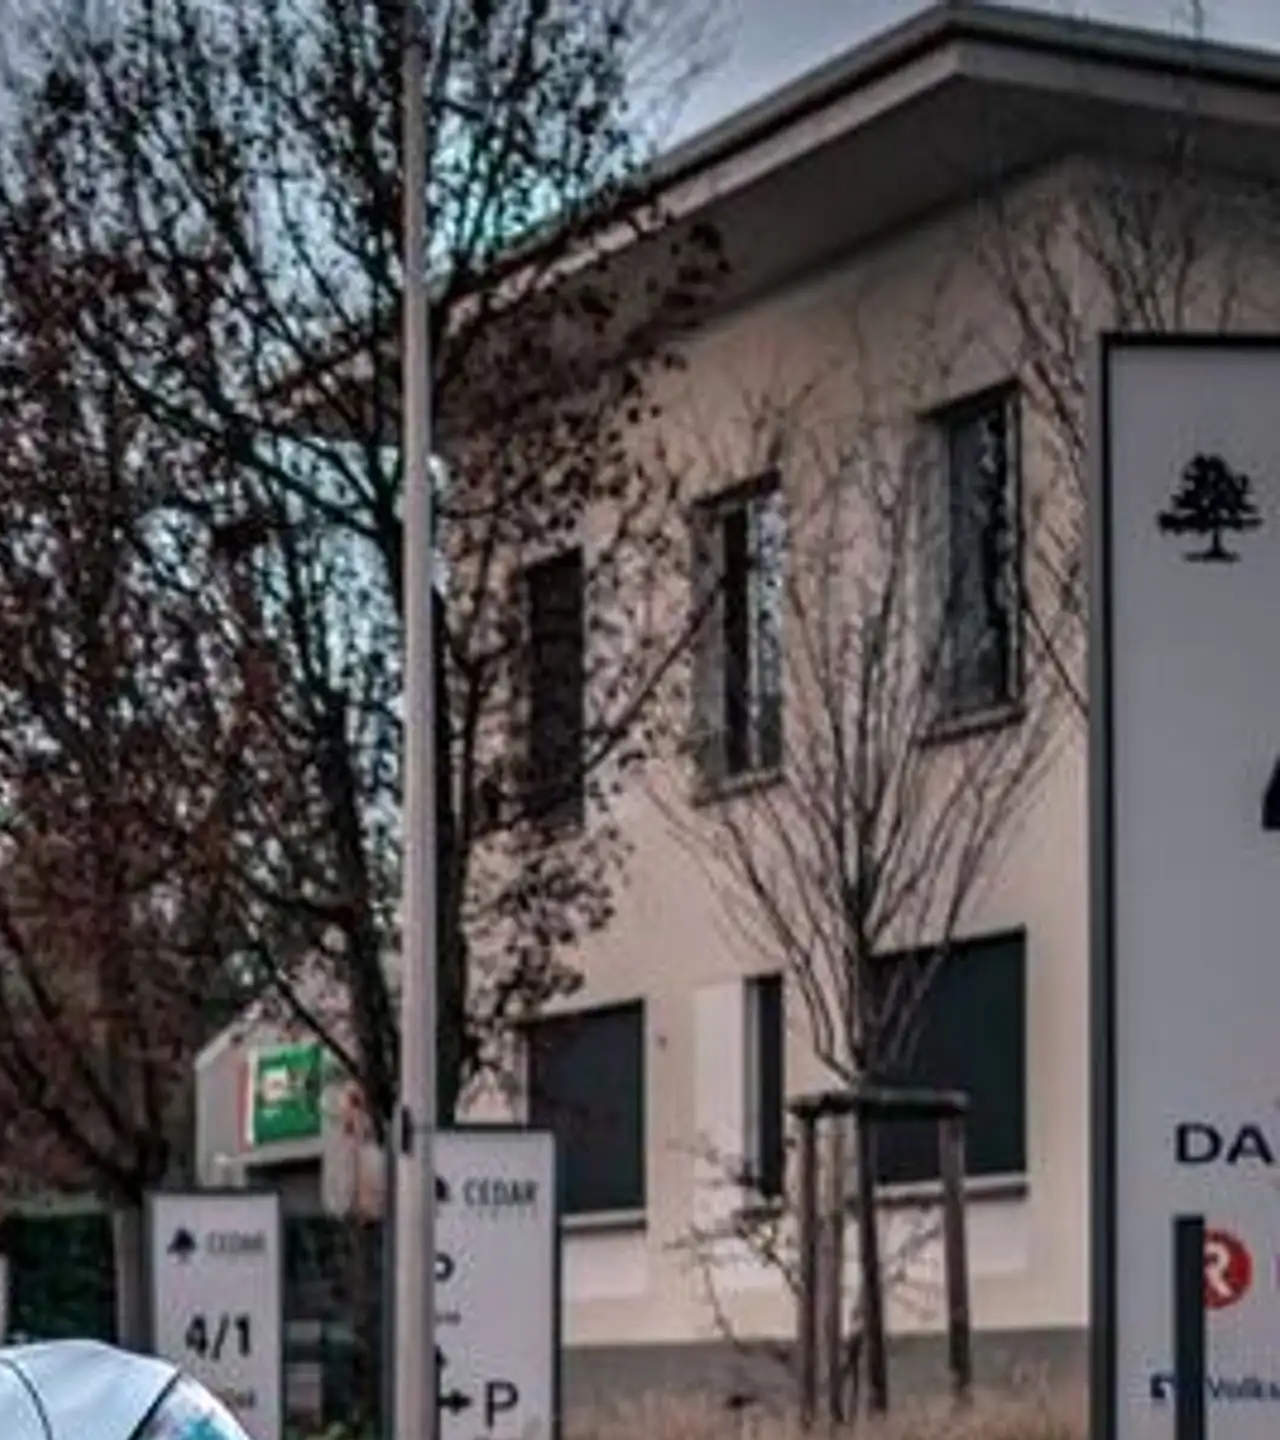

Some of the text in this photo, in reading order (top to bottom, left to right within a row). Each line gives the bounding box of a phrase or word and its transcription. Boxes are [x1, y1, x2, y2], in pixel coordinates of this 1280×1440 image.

[1175, 1120, 1276, 1166] DA
[462, 1177, 538, 1206] CEDAR
[185, 1313, 251, 1361] 4/1
[484, 1378, 519, 1429] P
